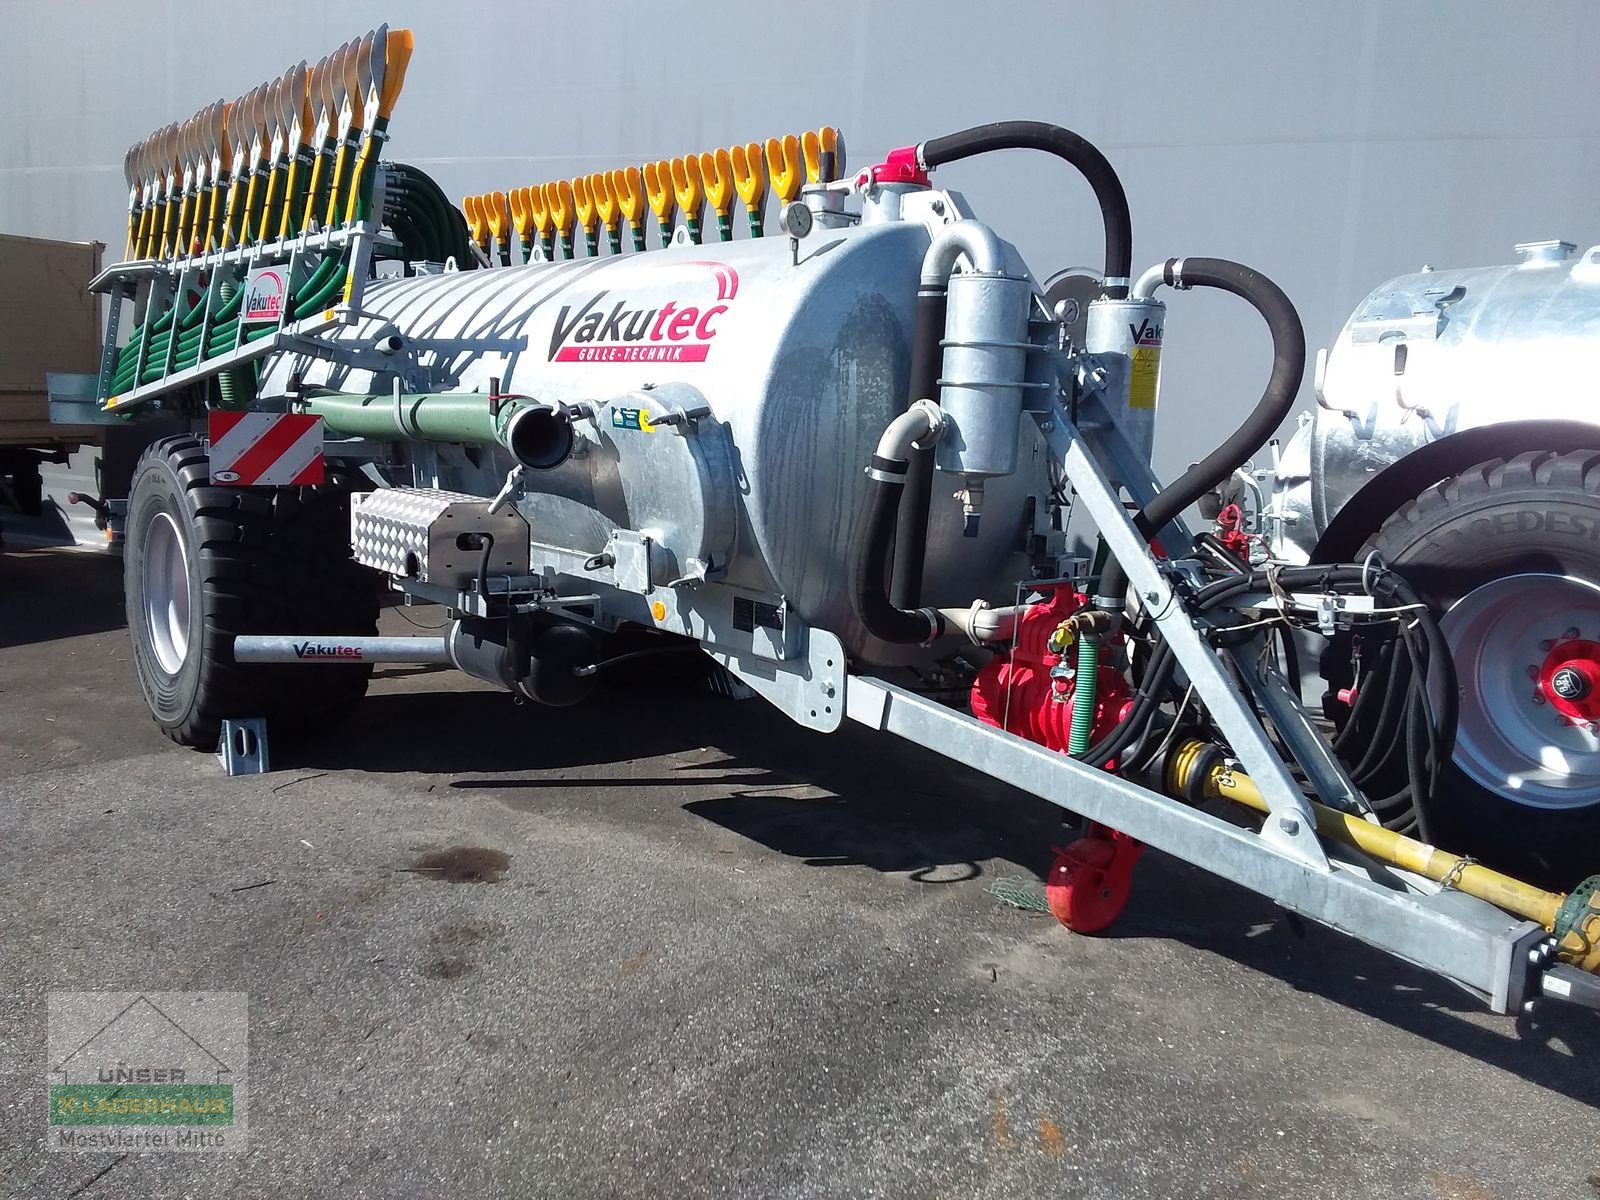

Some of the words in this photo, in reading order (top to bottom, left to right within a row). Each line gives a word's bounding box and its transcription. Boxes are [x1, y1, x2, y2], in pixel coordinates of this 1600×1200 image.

[246, 287, 282, 318] Vakutec
[547, 289, 730, 362] Vakutec
[293, 641, 362, 658] Vakutec
